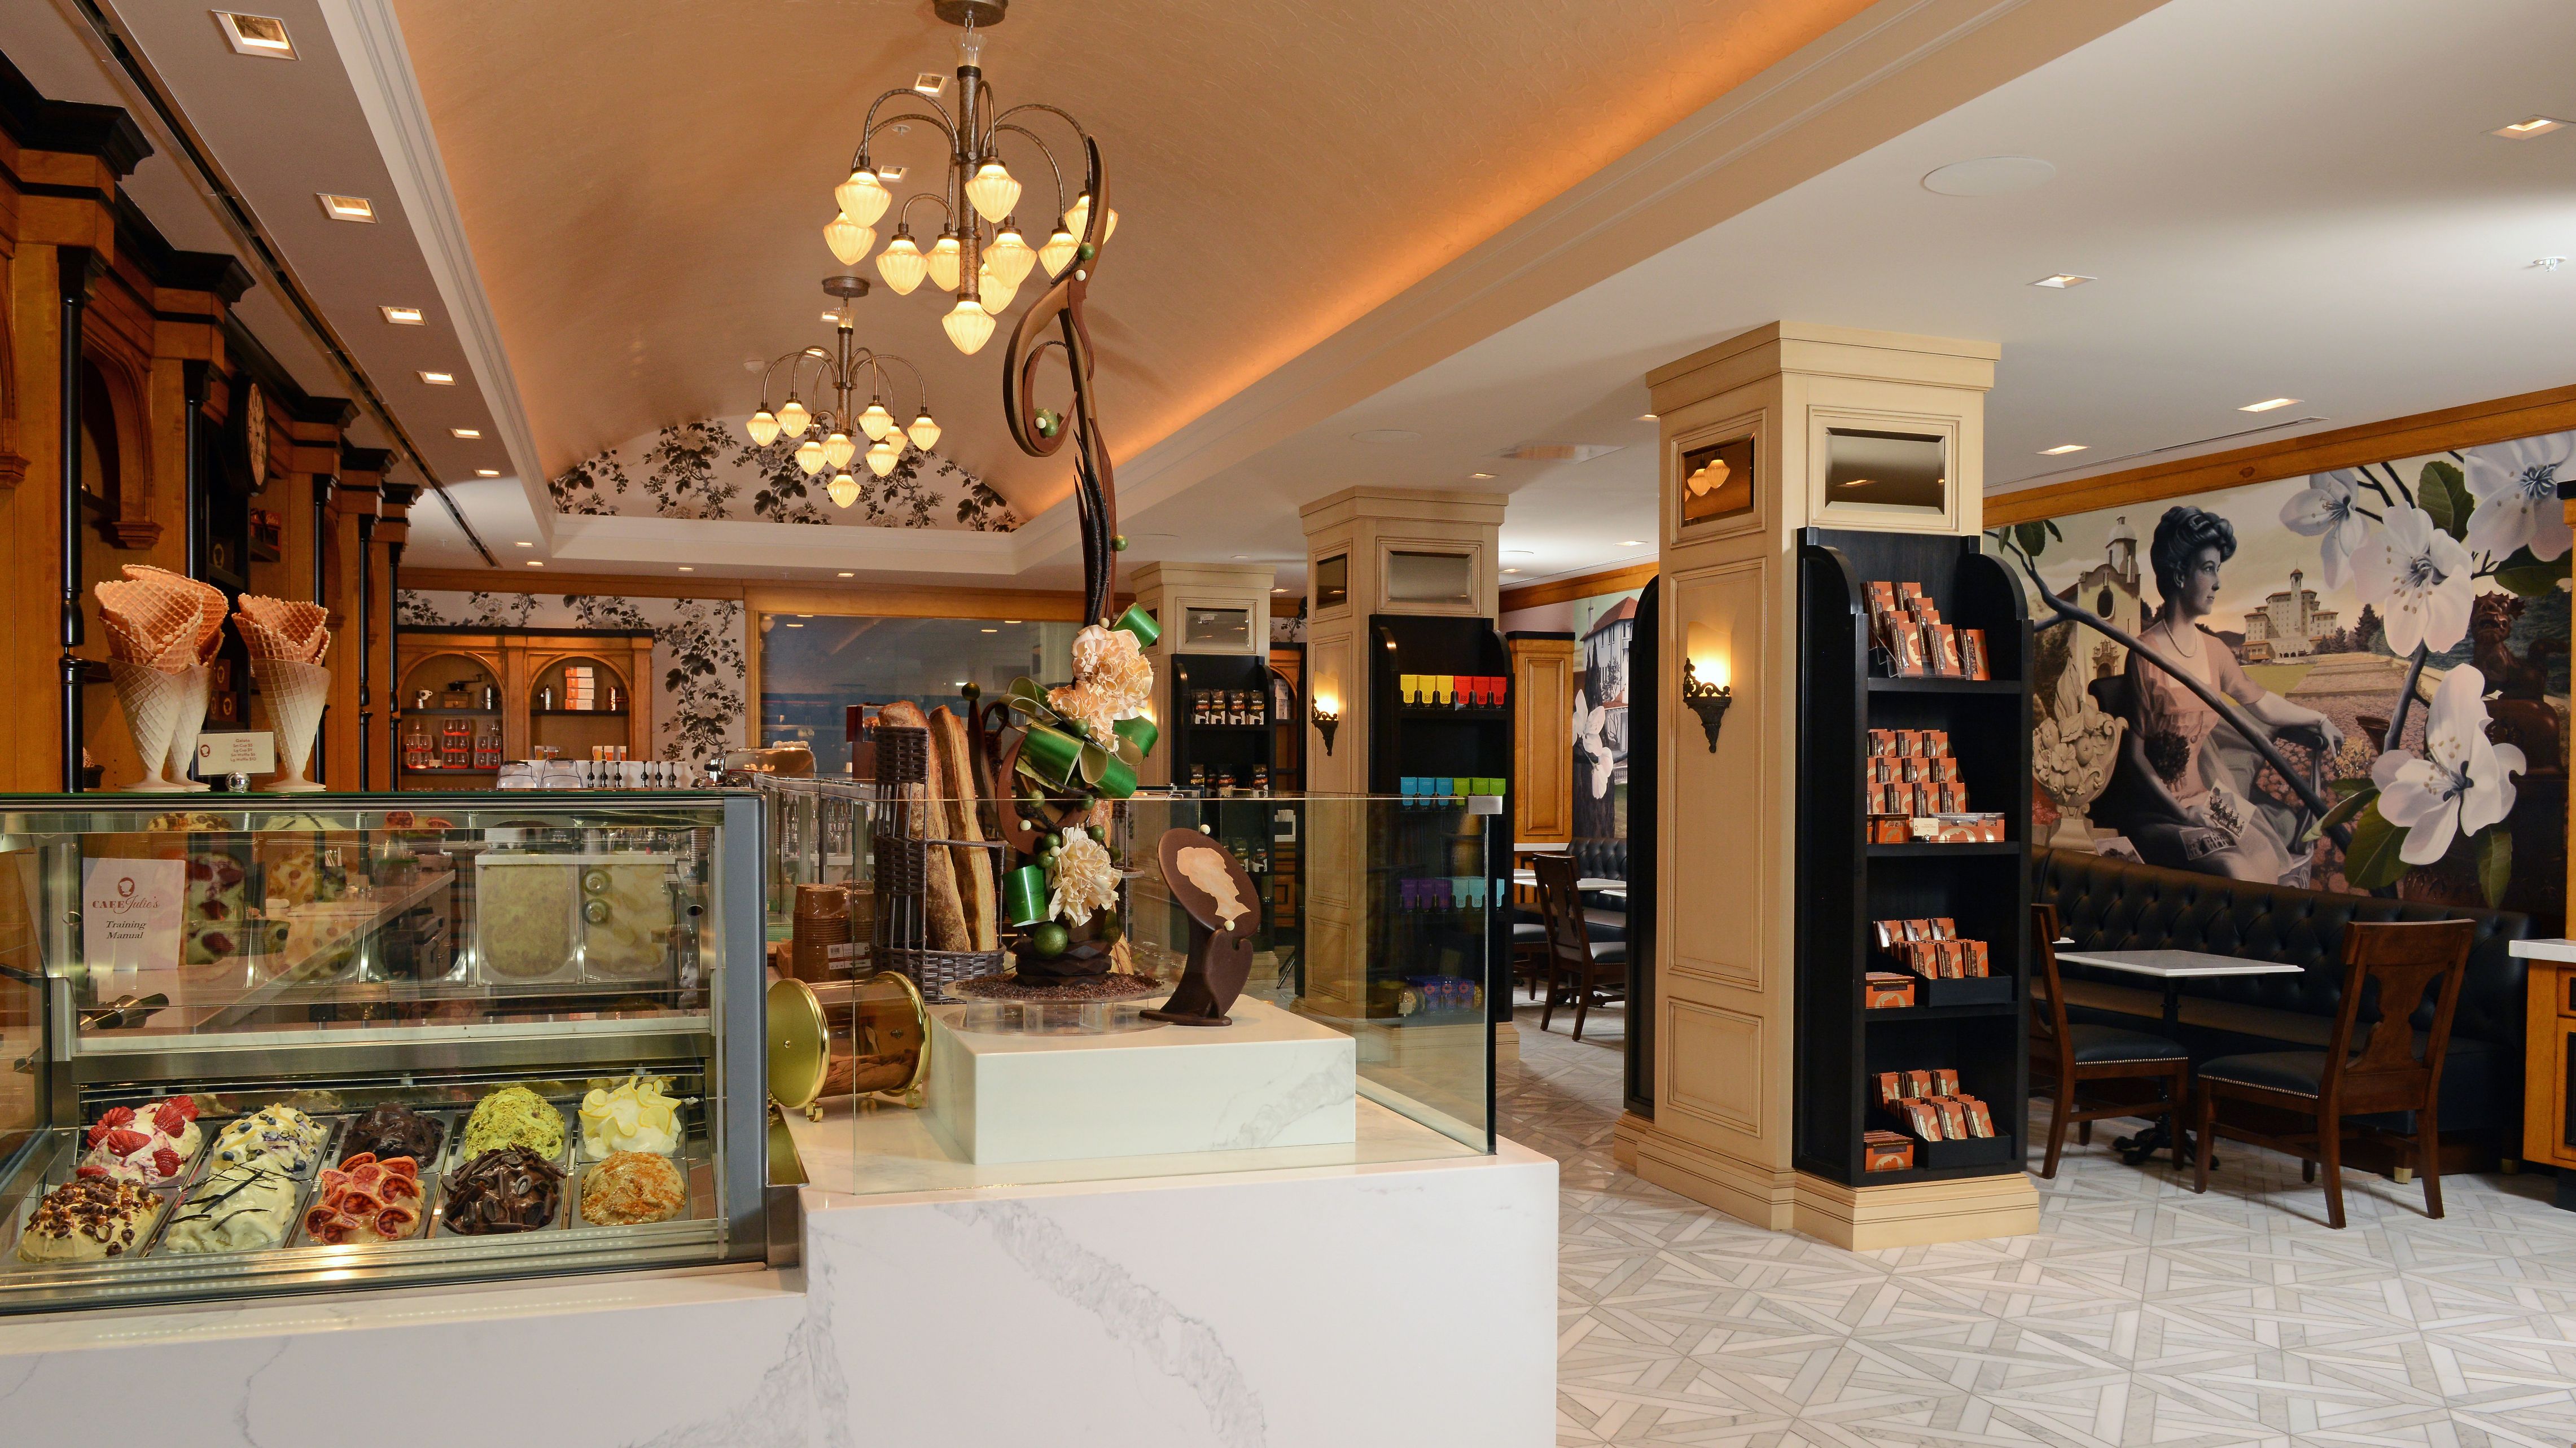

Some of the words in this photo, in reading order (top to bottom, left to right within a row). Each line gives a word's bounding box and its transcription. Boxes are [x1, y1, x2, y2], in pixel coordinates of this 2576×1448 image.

[92, 900, 125, 909] CAFE
[113, 894, 159, 914] Julie's
[106, 921, 147, 930] Training
